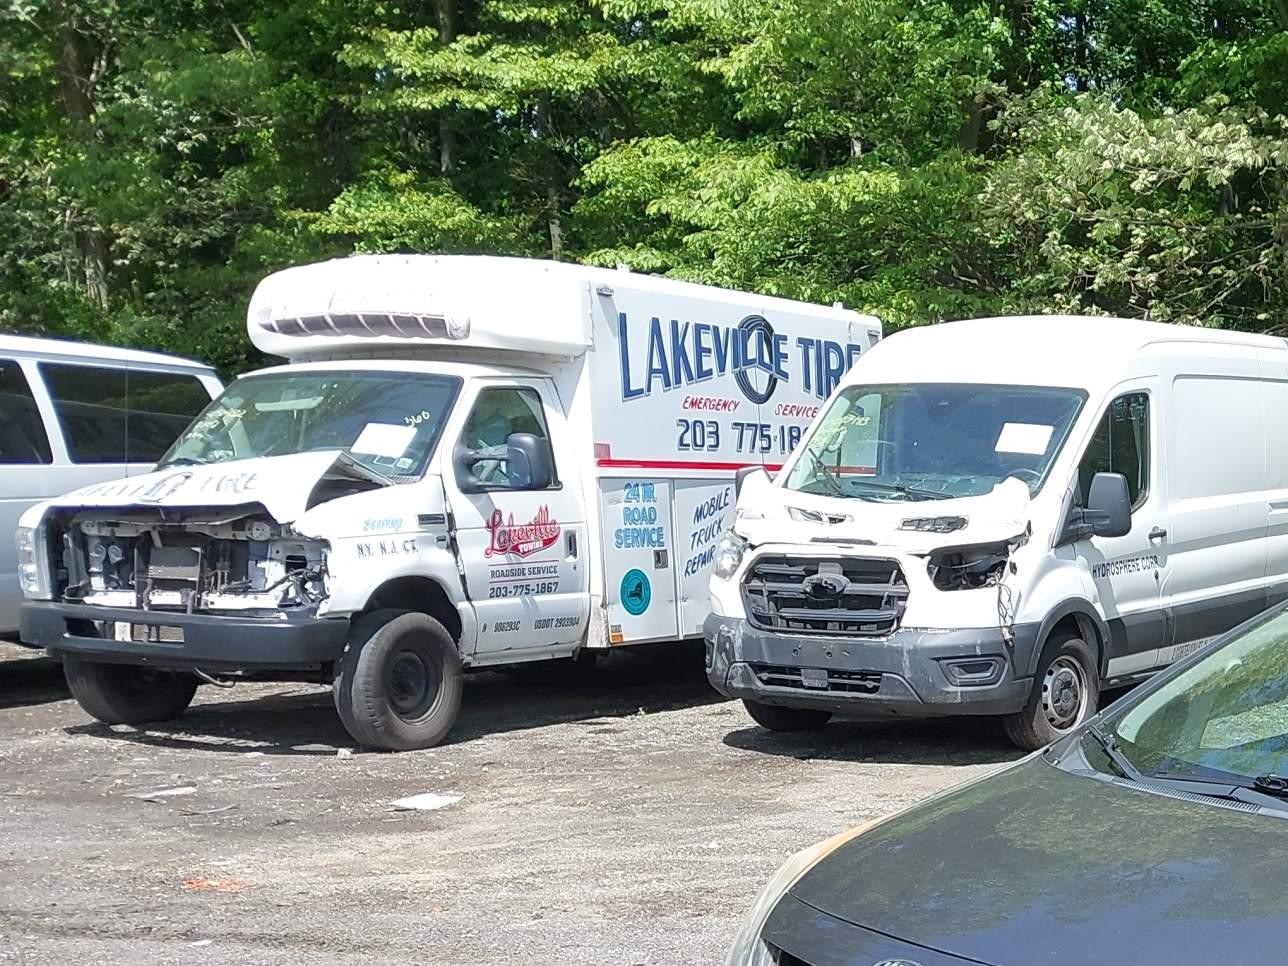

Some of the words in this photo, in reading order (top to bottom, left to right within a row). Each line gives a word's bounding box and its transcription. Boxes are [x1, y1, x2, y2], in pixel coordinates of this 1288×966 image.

[618, 312, 789, 402] LAKEVILLE
[682, 396, 740, 412] EMERGENCY
[676, 418, 720, 452] 203
[624, 482, 640, 503] 24
[622, 507, 657, 526] ROAD
[693, 487, 730, 525] MOBILE
[614, 527, 665, 549] SERVICE
[690, 516, 725, 551] TRUCK
[490, 566, 526, 579] ROADSIDE
[527, 565, 558, 576] SERVICE
[684, 545, 716, 578] REPAIR
[489, 581, 559, 599] 203-775-1867
